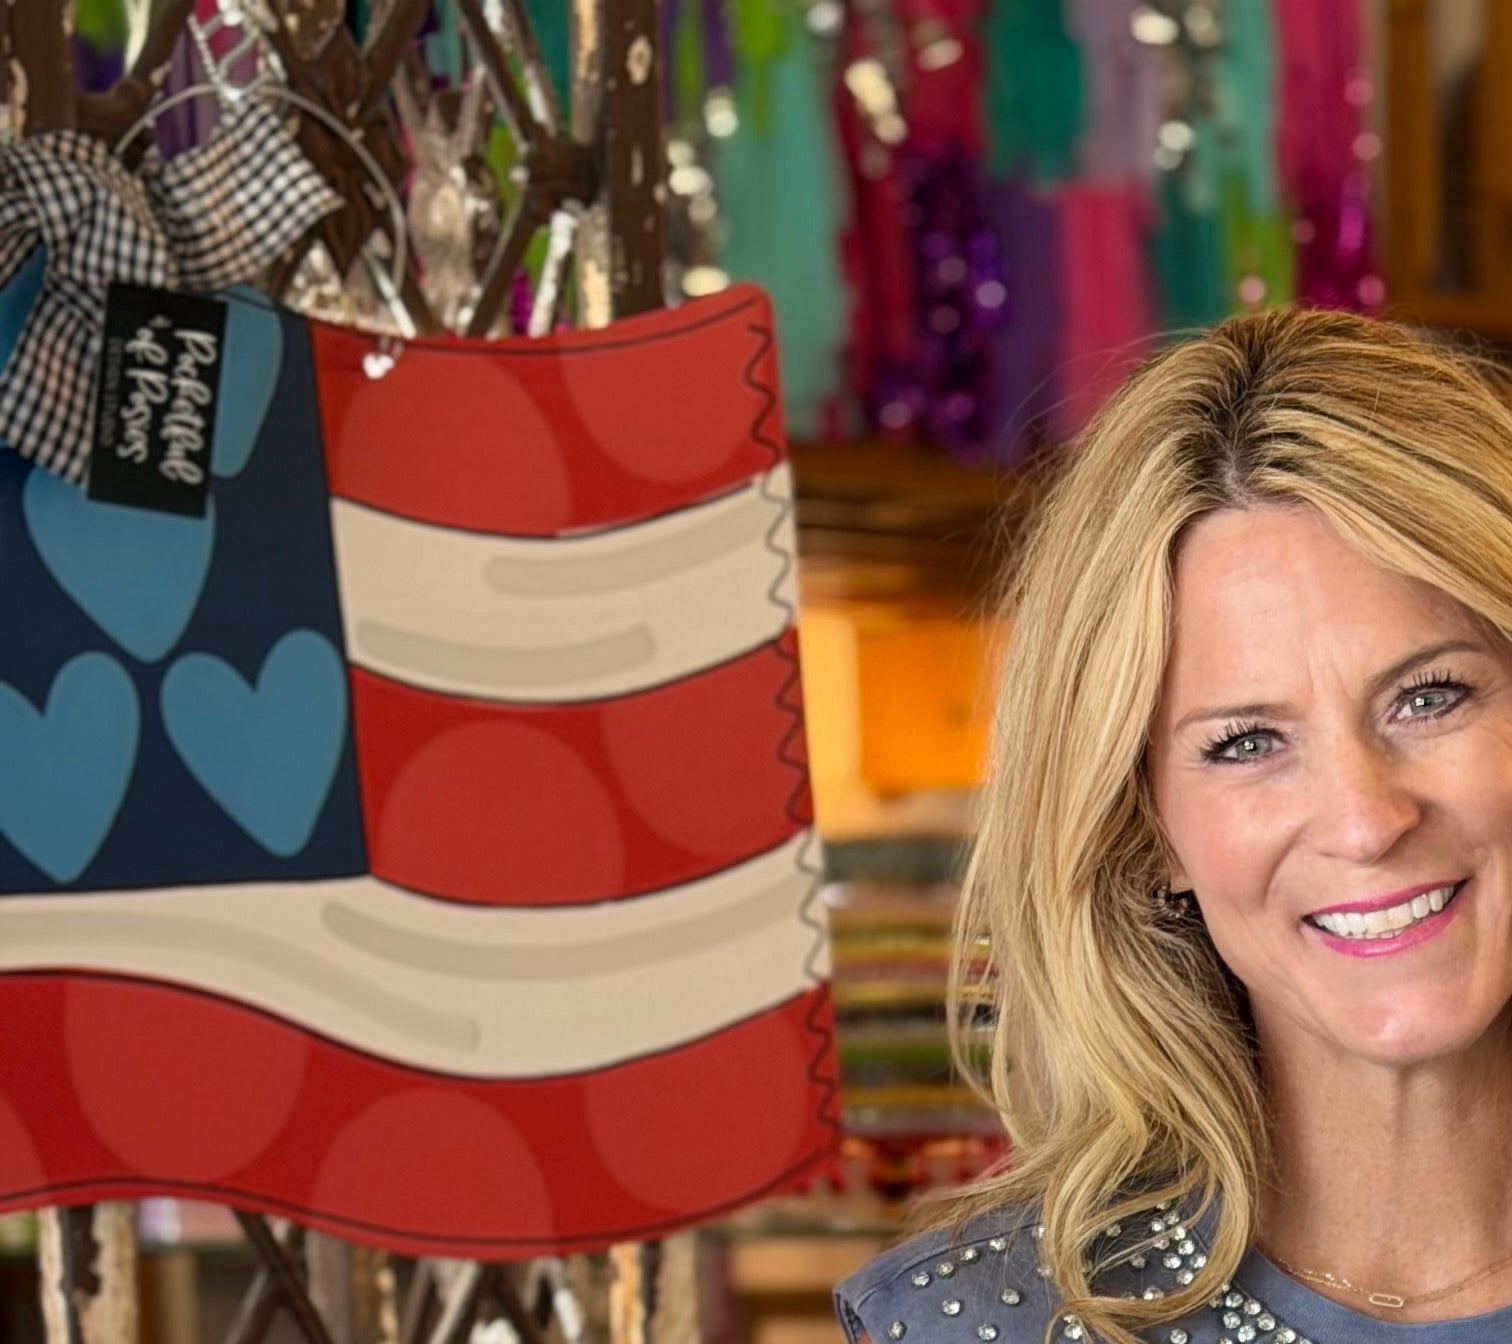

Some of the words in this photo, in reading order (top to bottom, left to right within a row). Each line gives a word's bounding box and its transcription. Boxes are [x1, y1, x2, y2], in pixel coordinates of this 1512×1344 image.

[125, 328, 169, 366] of
[116, 368, 169, 462] Posies
[159, 329, 217, 485] Pocketful
